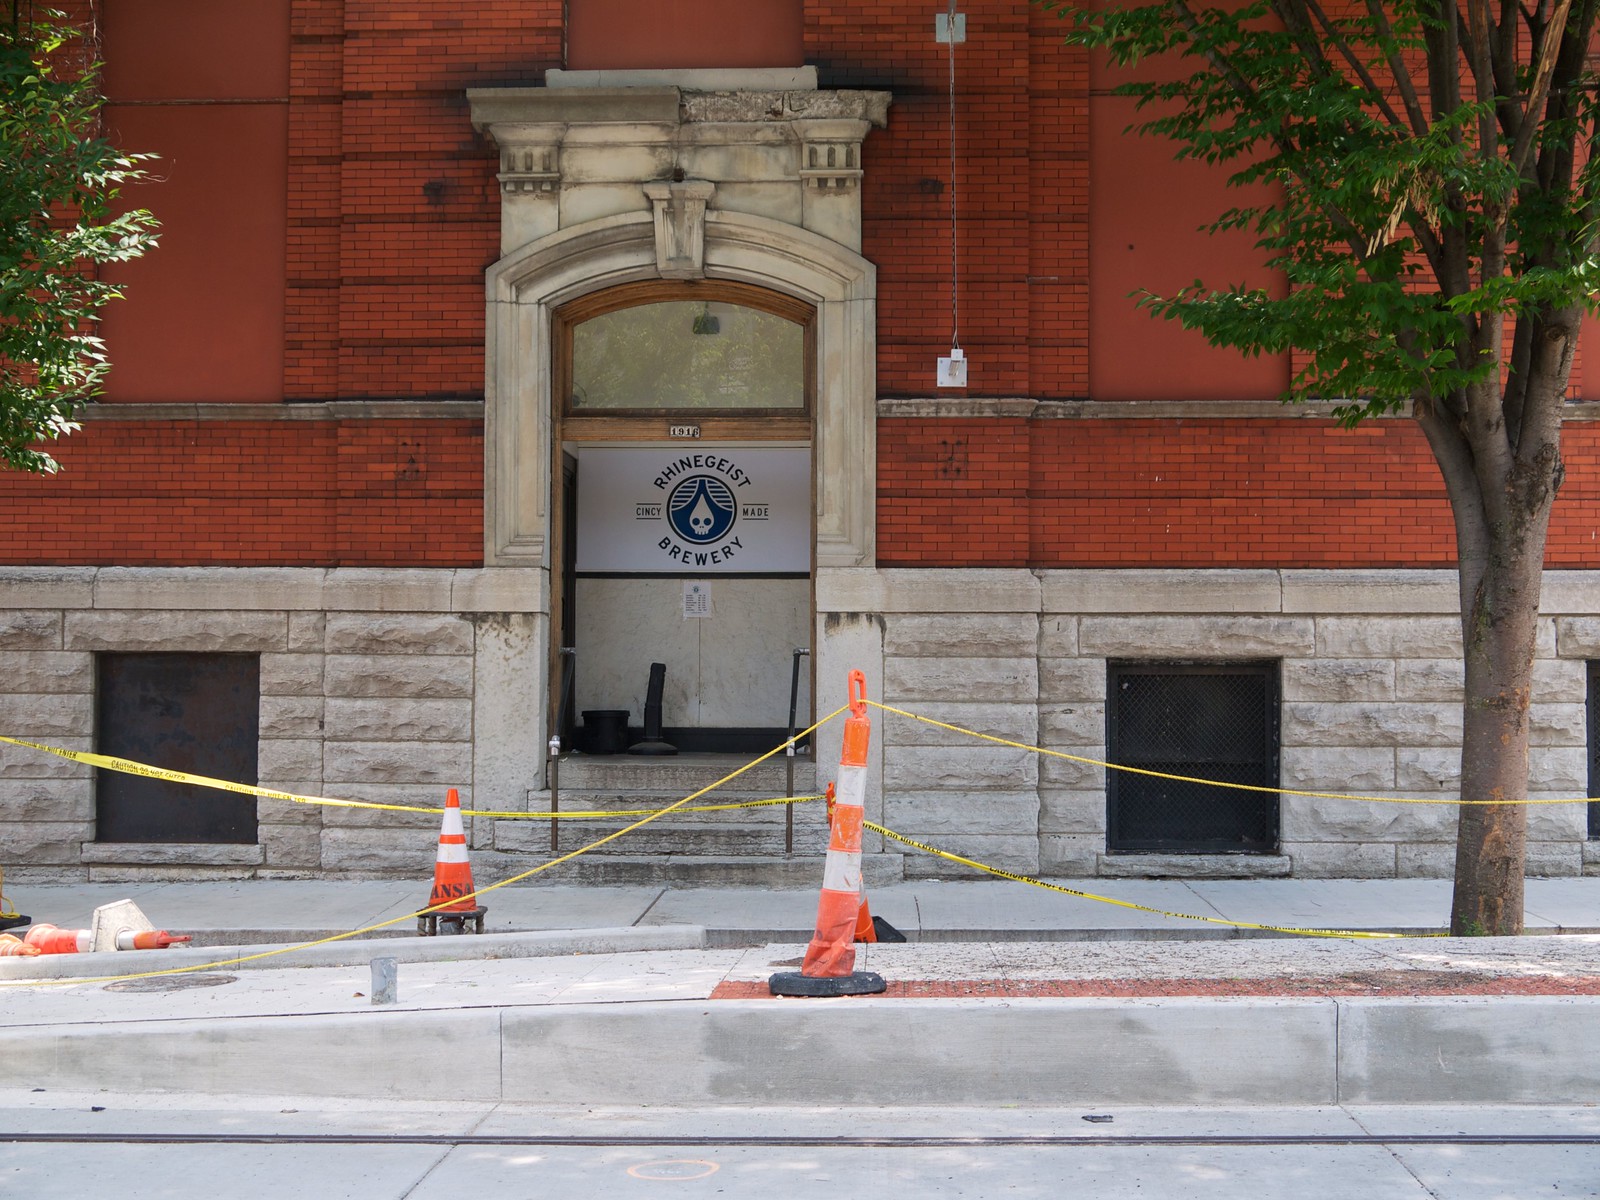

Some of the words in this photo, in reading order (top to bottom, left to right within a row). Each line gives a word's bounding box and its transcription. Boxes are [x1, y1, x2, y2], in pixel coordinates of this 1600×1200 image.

[653, 454, 752, 490] RHINEGEIST
[636, 507, 661, 516] CINCY
[742, 508, 769, 517] MADE
[658, 536, 744, 566] BREWERY
[111, 760, 139, 773] CAUTION
